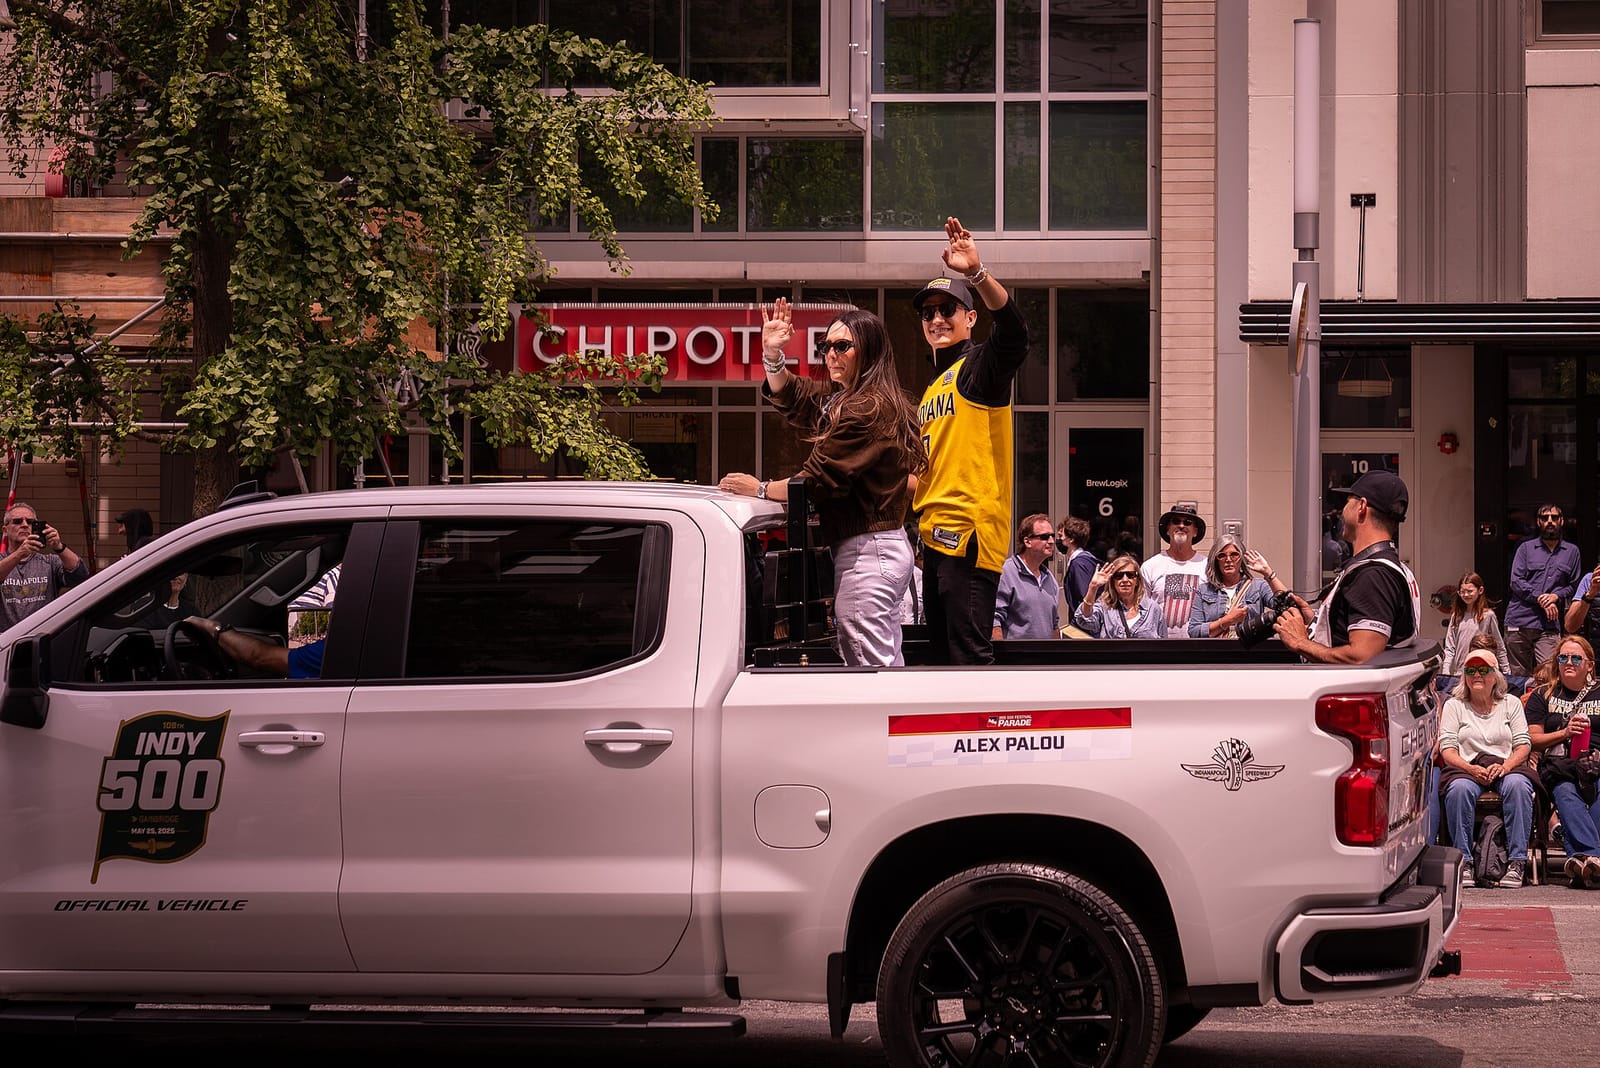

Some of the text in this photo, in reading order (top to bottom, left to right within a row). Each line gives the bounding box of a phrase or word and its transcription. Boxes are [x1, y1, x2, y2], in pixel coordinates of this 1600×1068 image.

[532, 325, 829, 365] CHIPOTE
[918, 391, 956, 428] DIANA
[1351, 460, 1369, 474] 10
[1085, 479, 1128, 489] BrewLogix
[1098, 497, 1114, 517] 6
[2, 576, 48, 586] NDIAAPOLIS
[1549, 696, 1574, 709] WARRE
[998, 719, 1032, 728] PARADE
[135, 732, 206, 756] INDY
[953, 735, 1065, 753] ALEX PALOU
[1234, 761, 1242, 787] MOTOR
[100, 759, 222, 811] 500
[157, 827, 176, 835] 2025
[54, 900, 248, 911] OFFICIAL VEHICLE
